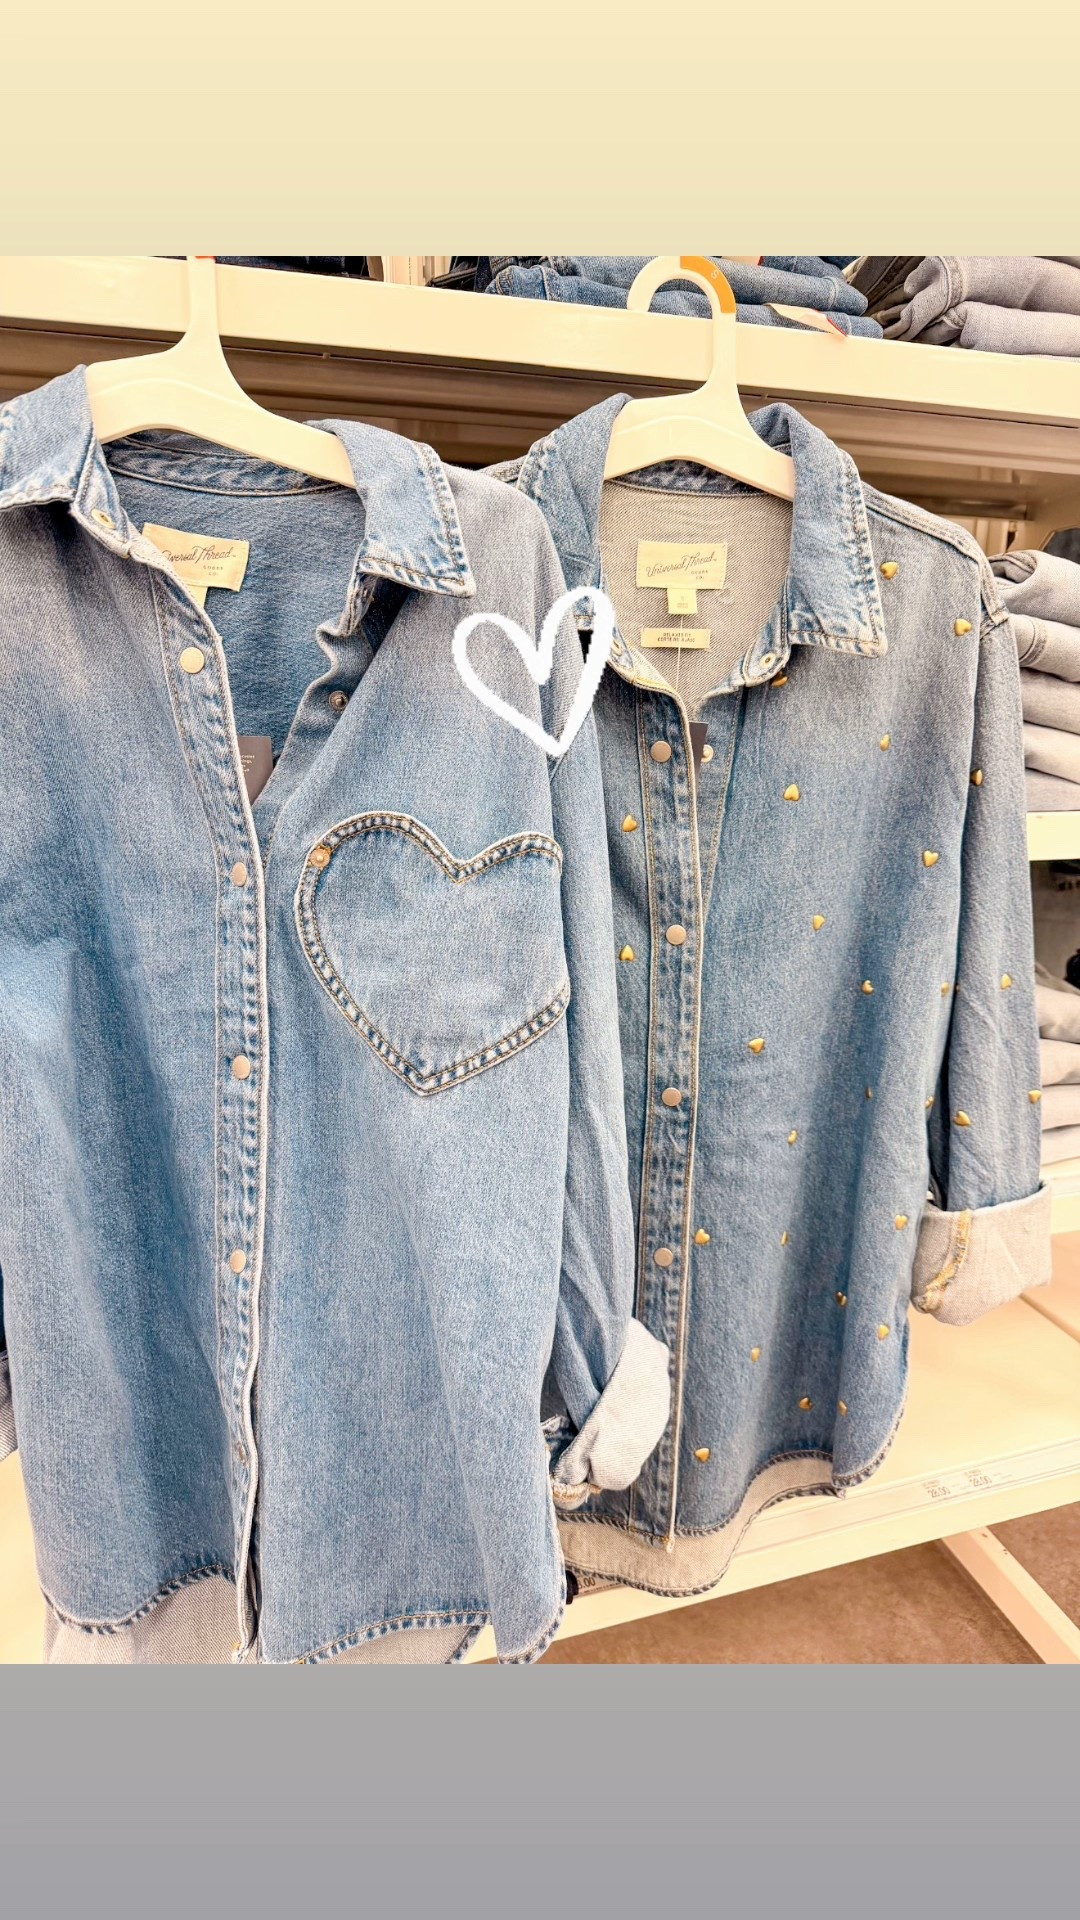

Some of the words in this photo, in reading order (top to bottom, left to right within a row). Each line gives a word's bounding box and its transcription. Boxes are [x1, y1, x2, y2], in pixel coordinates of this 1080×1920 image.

[192, 545, 234, 564] Thread
[645, 557, 687, 577] Universal
[681, 551, 715, 571] Thread
